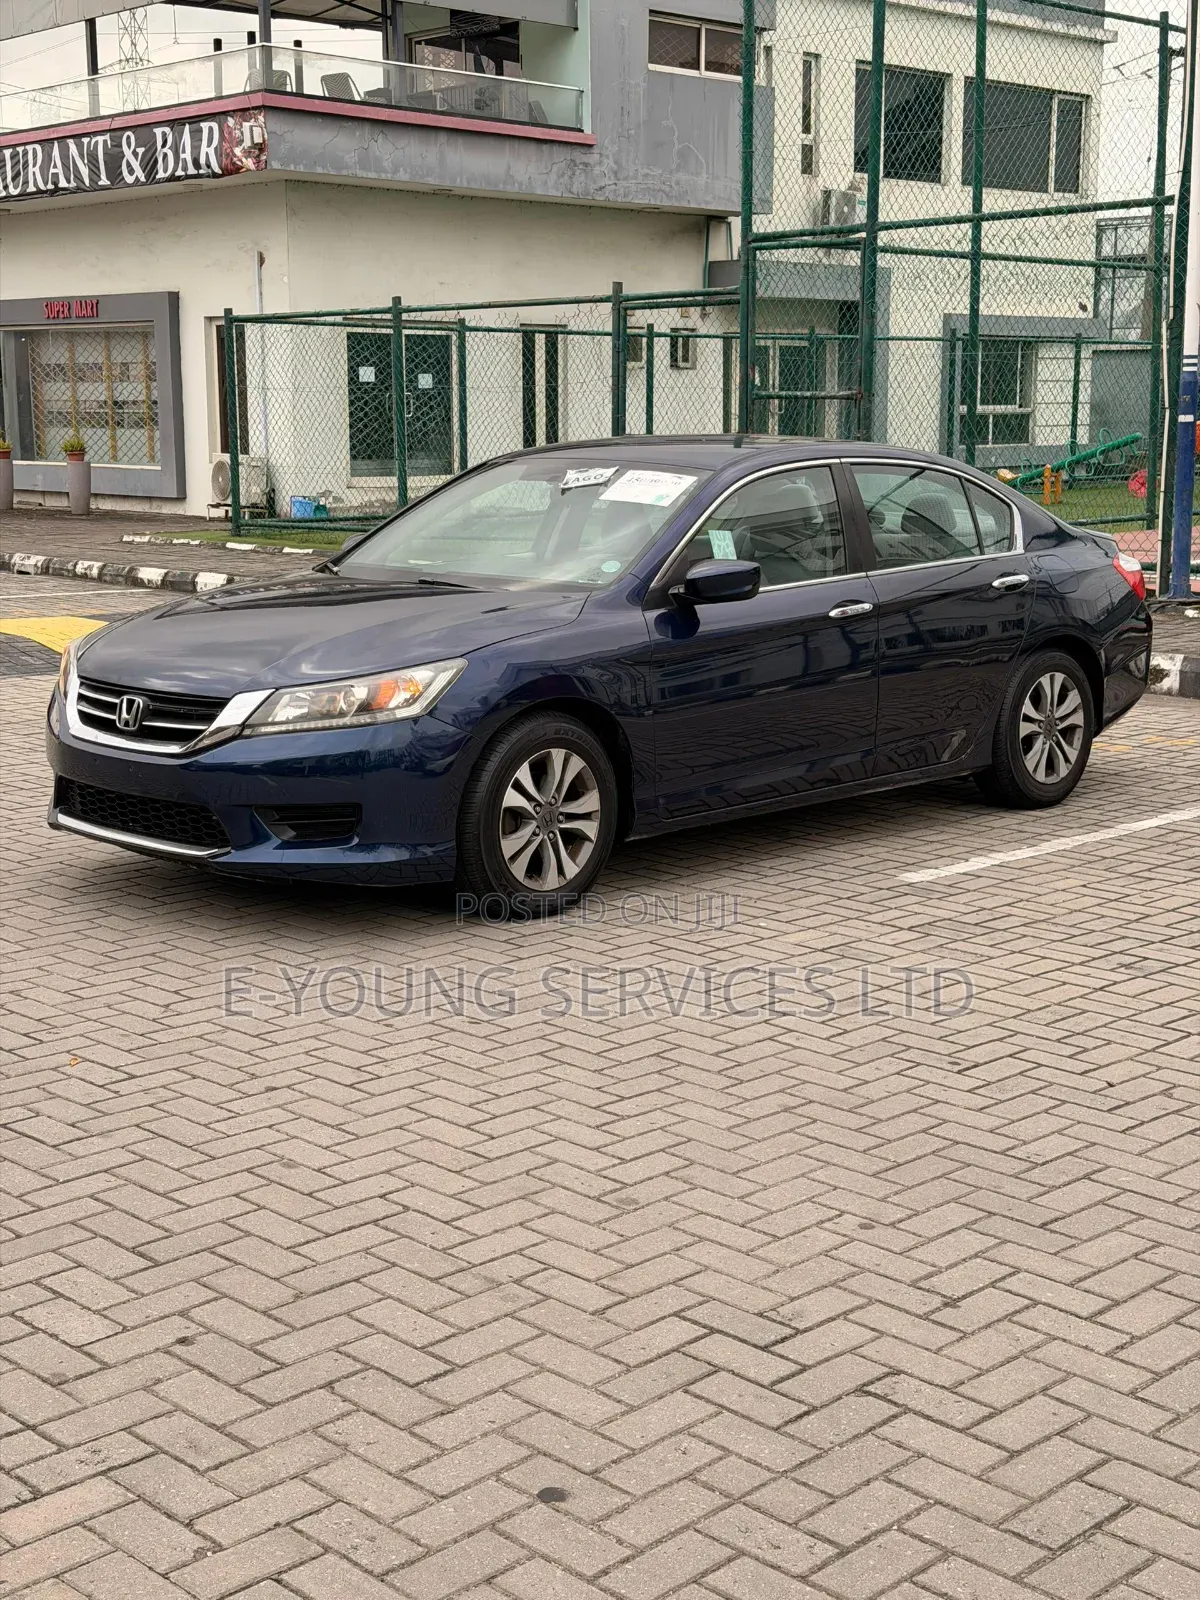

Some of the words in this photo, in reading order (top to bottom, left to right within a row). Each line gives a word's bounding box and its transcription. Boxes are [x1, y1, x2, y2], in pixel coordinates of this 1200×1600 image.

[0, 133, 111, 197] URANT
[121, 130, 147, 185] &
[153, 121, 223, 179] BAR
[43, 301, 70, 319] SUPER
[73, 299, 99, 318] MART
